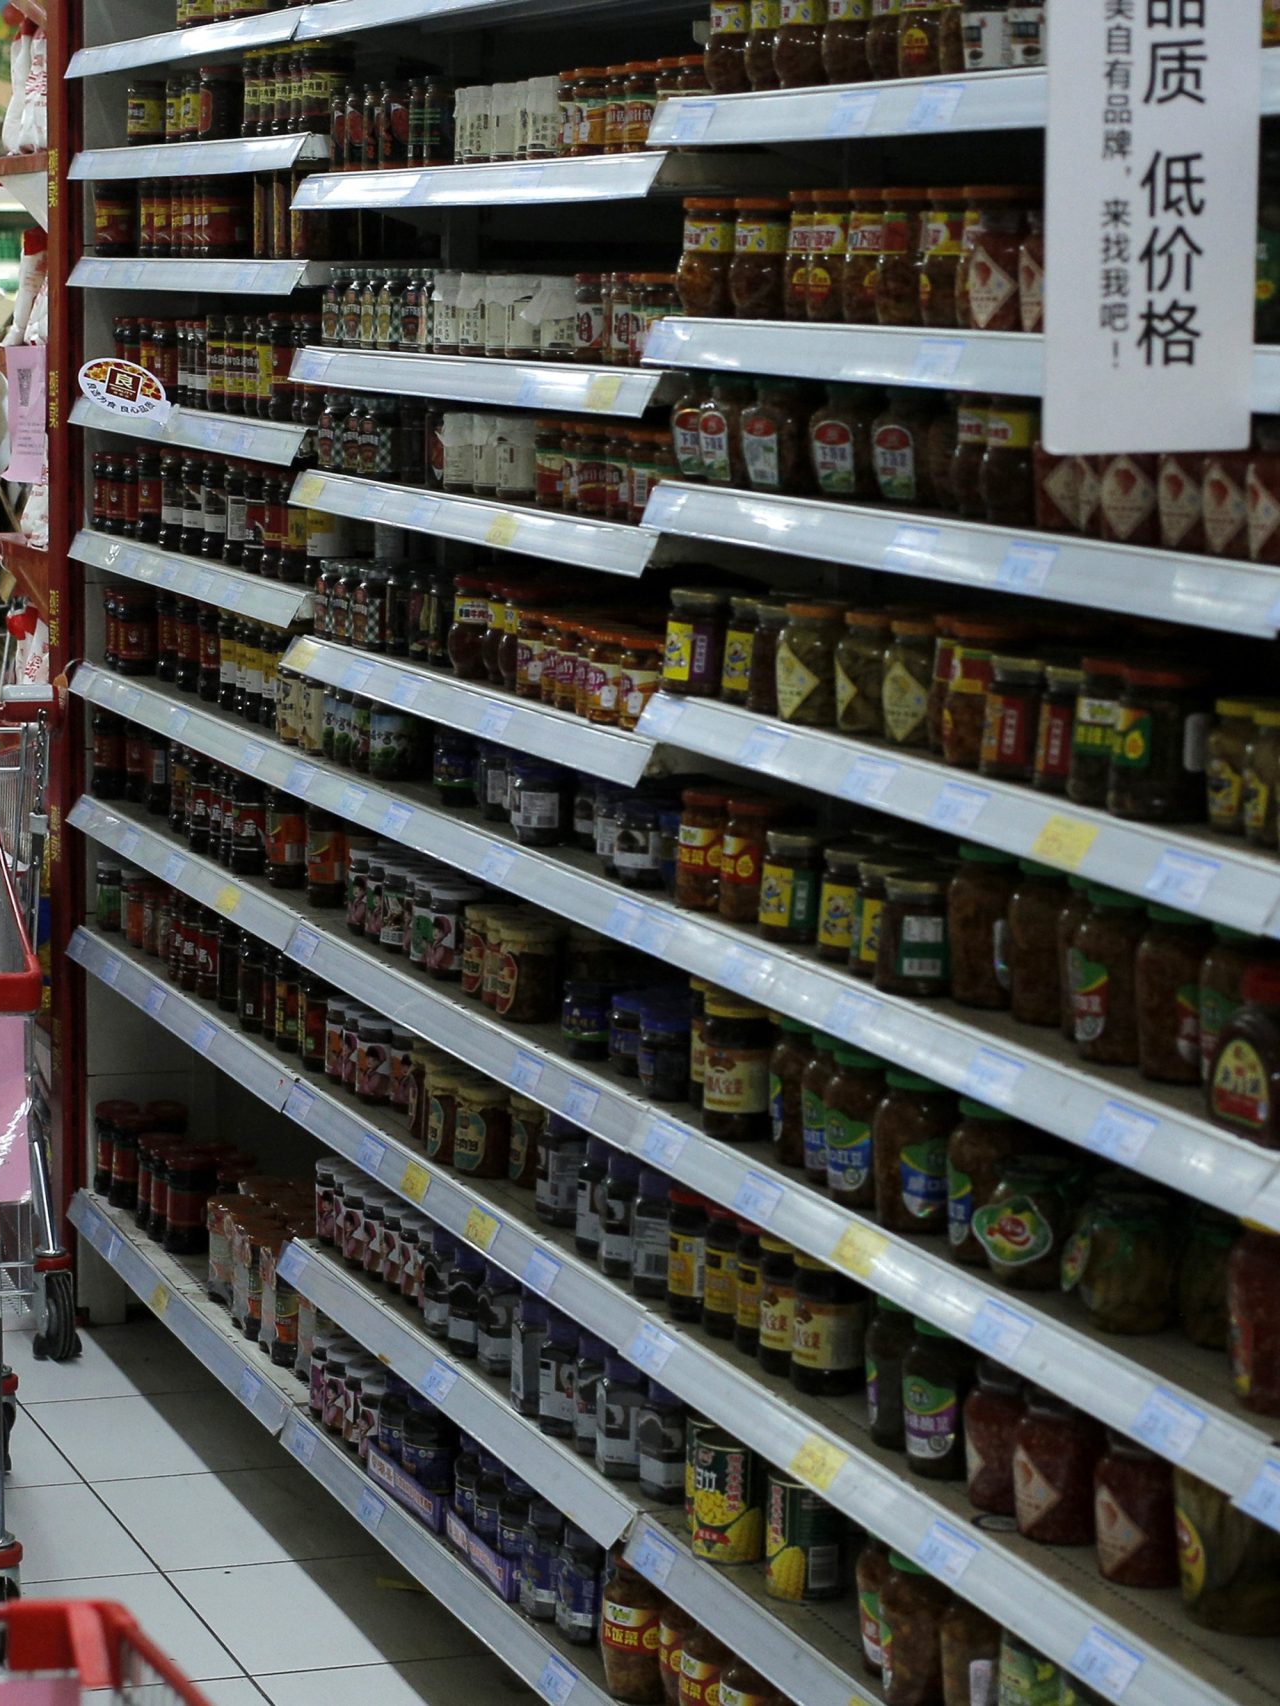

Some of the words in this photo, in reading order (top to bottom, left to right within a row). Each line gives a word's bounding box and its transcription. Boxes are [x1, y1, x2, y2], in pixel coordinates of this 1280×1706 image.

[1143, 0, 1208, 103] 品质
[1136, 150, 1207, 367] 低价格
[604, 1622, 639, 1646] 下饭菜
